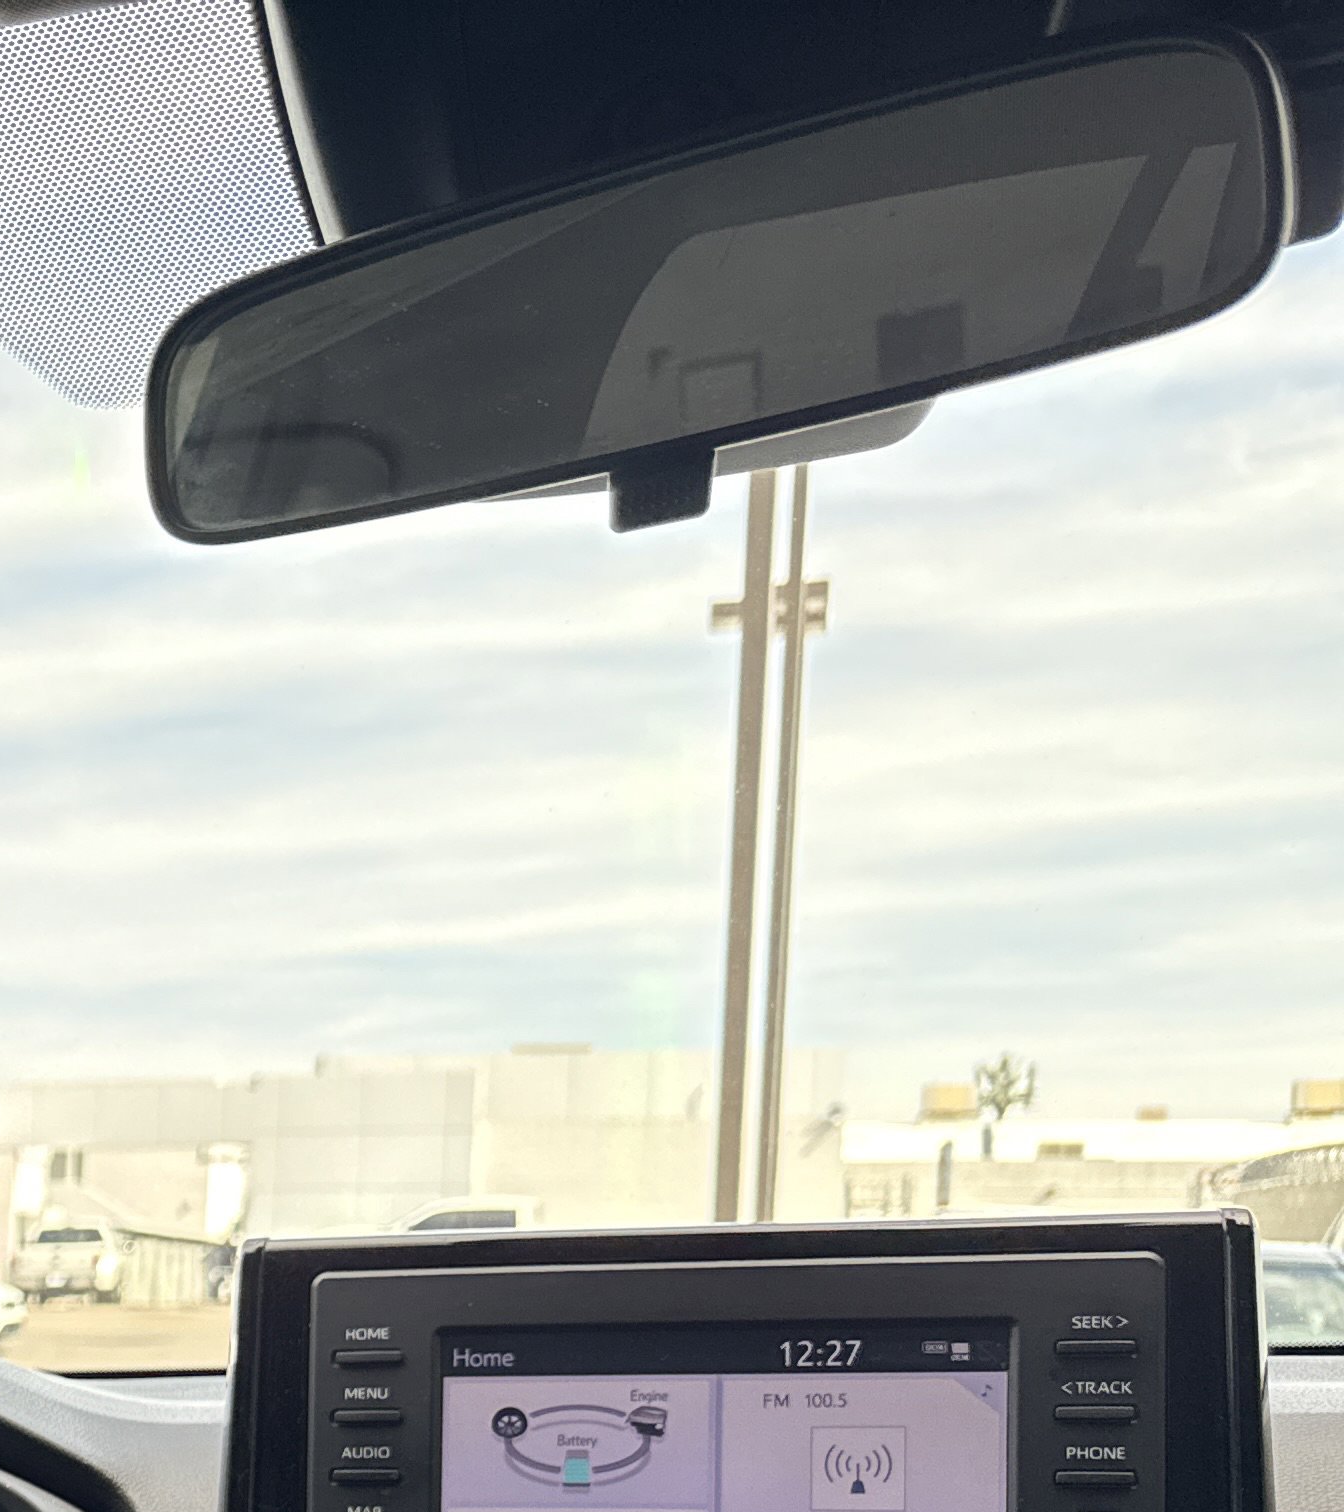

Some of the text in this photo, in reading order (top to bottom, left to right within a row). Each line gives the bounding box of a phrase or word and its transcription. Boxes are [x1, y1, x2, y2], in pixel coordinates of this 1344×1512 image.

[1071, 1315, 1113, 1329] SEEK
[345, 1327, 389, 1340] HOME
[452, 1348, 515, 1368] Home
[779, 1339, 862, 1368] 12:27
[344, 1387, 389, 1400] MENU
[1075, 1381, 1133, 1394] TRACK
[630, 1389, 669, 1403] Engine
[763, 1392, 848, 1409] FM 100.5
[557, 1434, 597, 1448] Battery
[341, 1446, 391, 1459] AUDIO
[1065, 1446, 1126, 1460] PHONE
